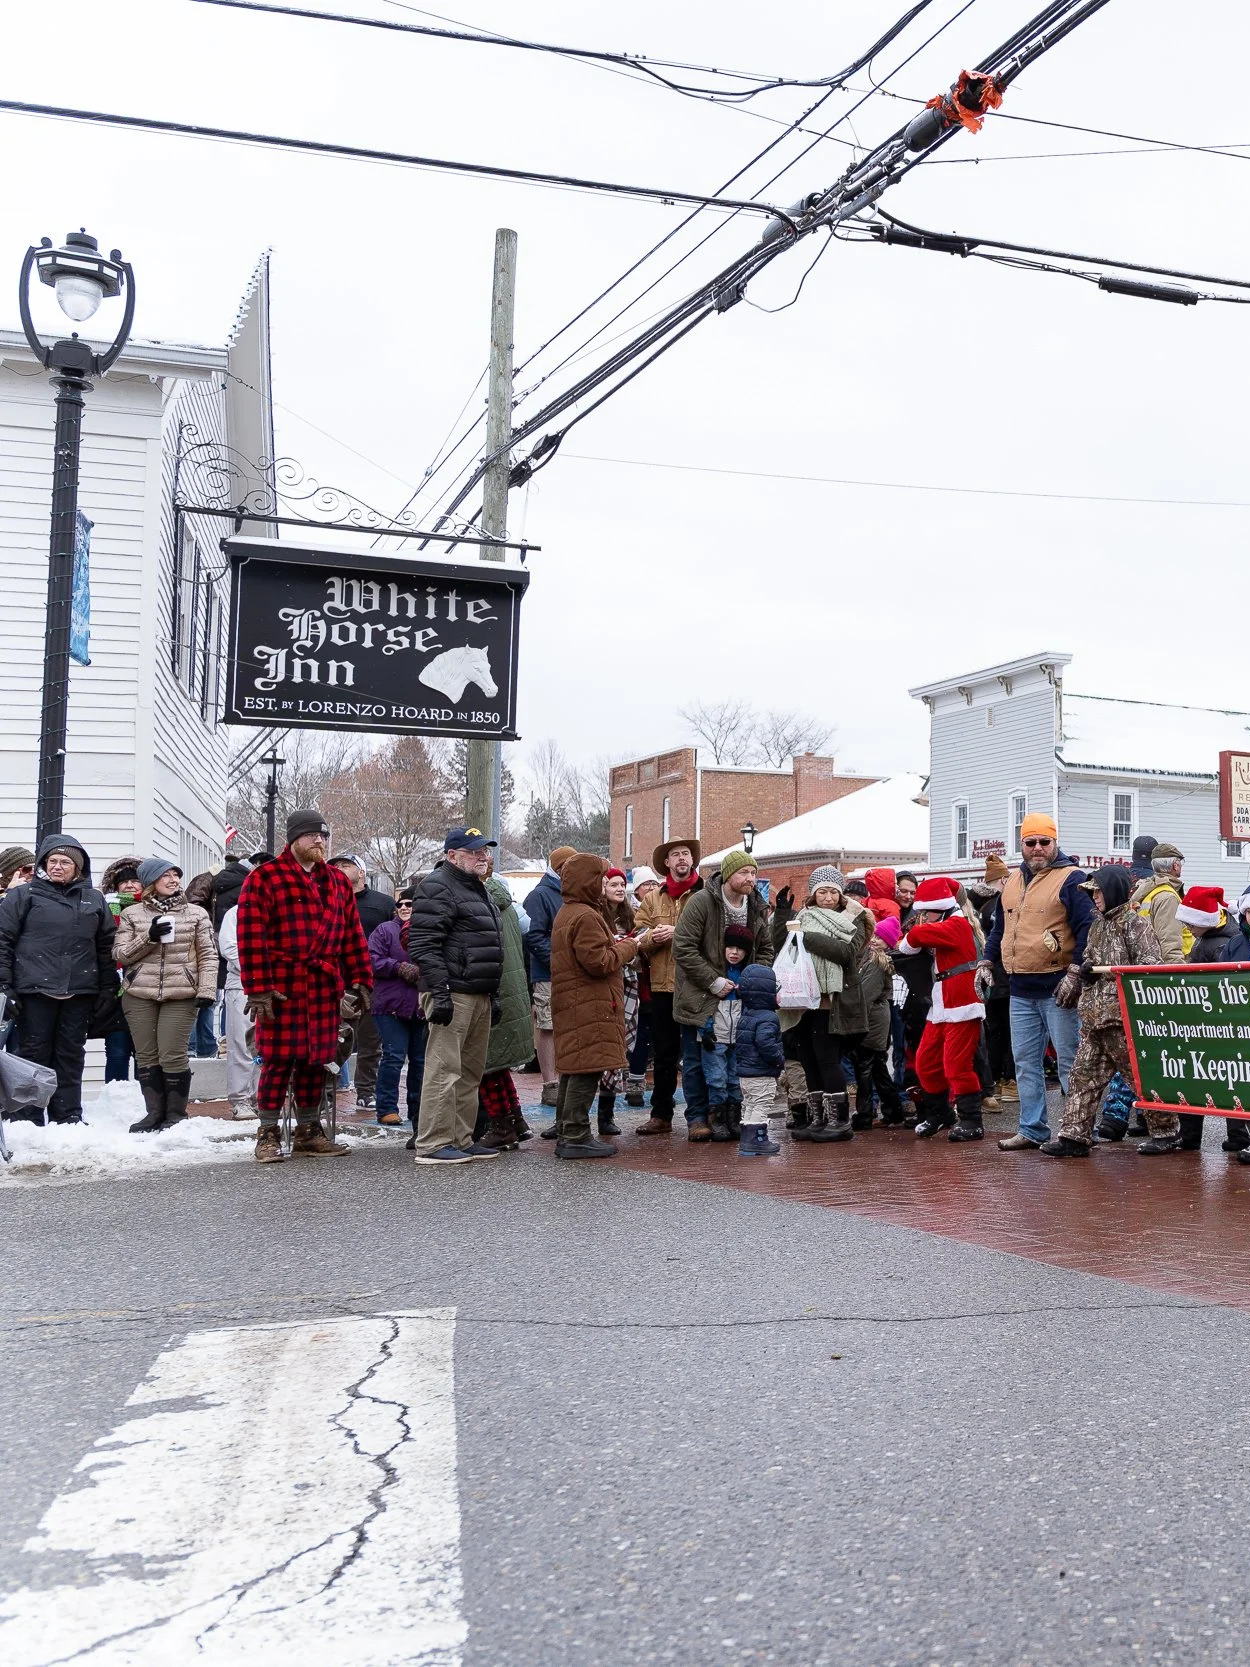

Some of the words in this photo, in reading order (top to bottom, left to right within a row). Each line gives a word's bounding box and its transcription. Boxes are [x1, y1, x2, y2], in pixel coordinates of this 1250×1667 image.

[323, 576, 498, 624] White
[278, 607, 443, 656] Horse
[253, 645, 355, 691] Inn
[244, 697, 278, 711] EST.
[281, 701, 294, 709] BY
[298, 700, 386, 717] LORENZO
[391, 706, 453, 721] HOARD
[457, 712, 468, 720] IN
[470, 711, 500, 724] 1850
[1236, 807, 1249, 815] DDA
[1235, 825, 1244, 833] 12
[1129, 977, 1213, 1012] Honoring
[1218, 978, 1249, 1005] the
[1136, 1019, 1168, 1037] Police
[1168, 1021, 1235, 1042] Department
[1160, 1049, 1186, 1079] for
